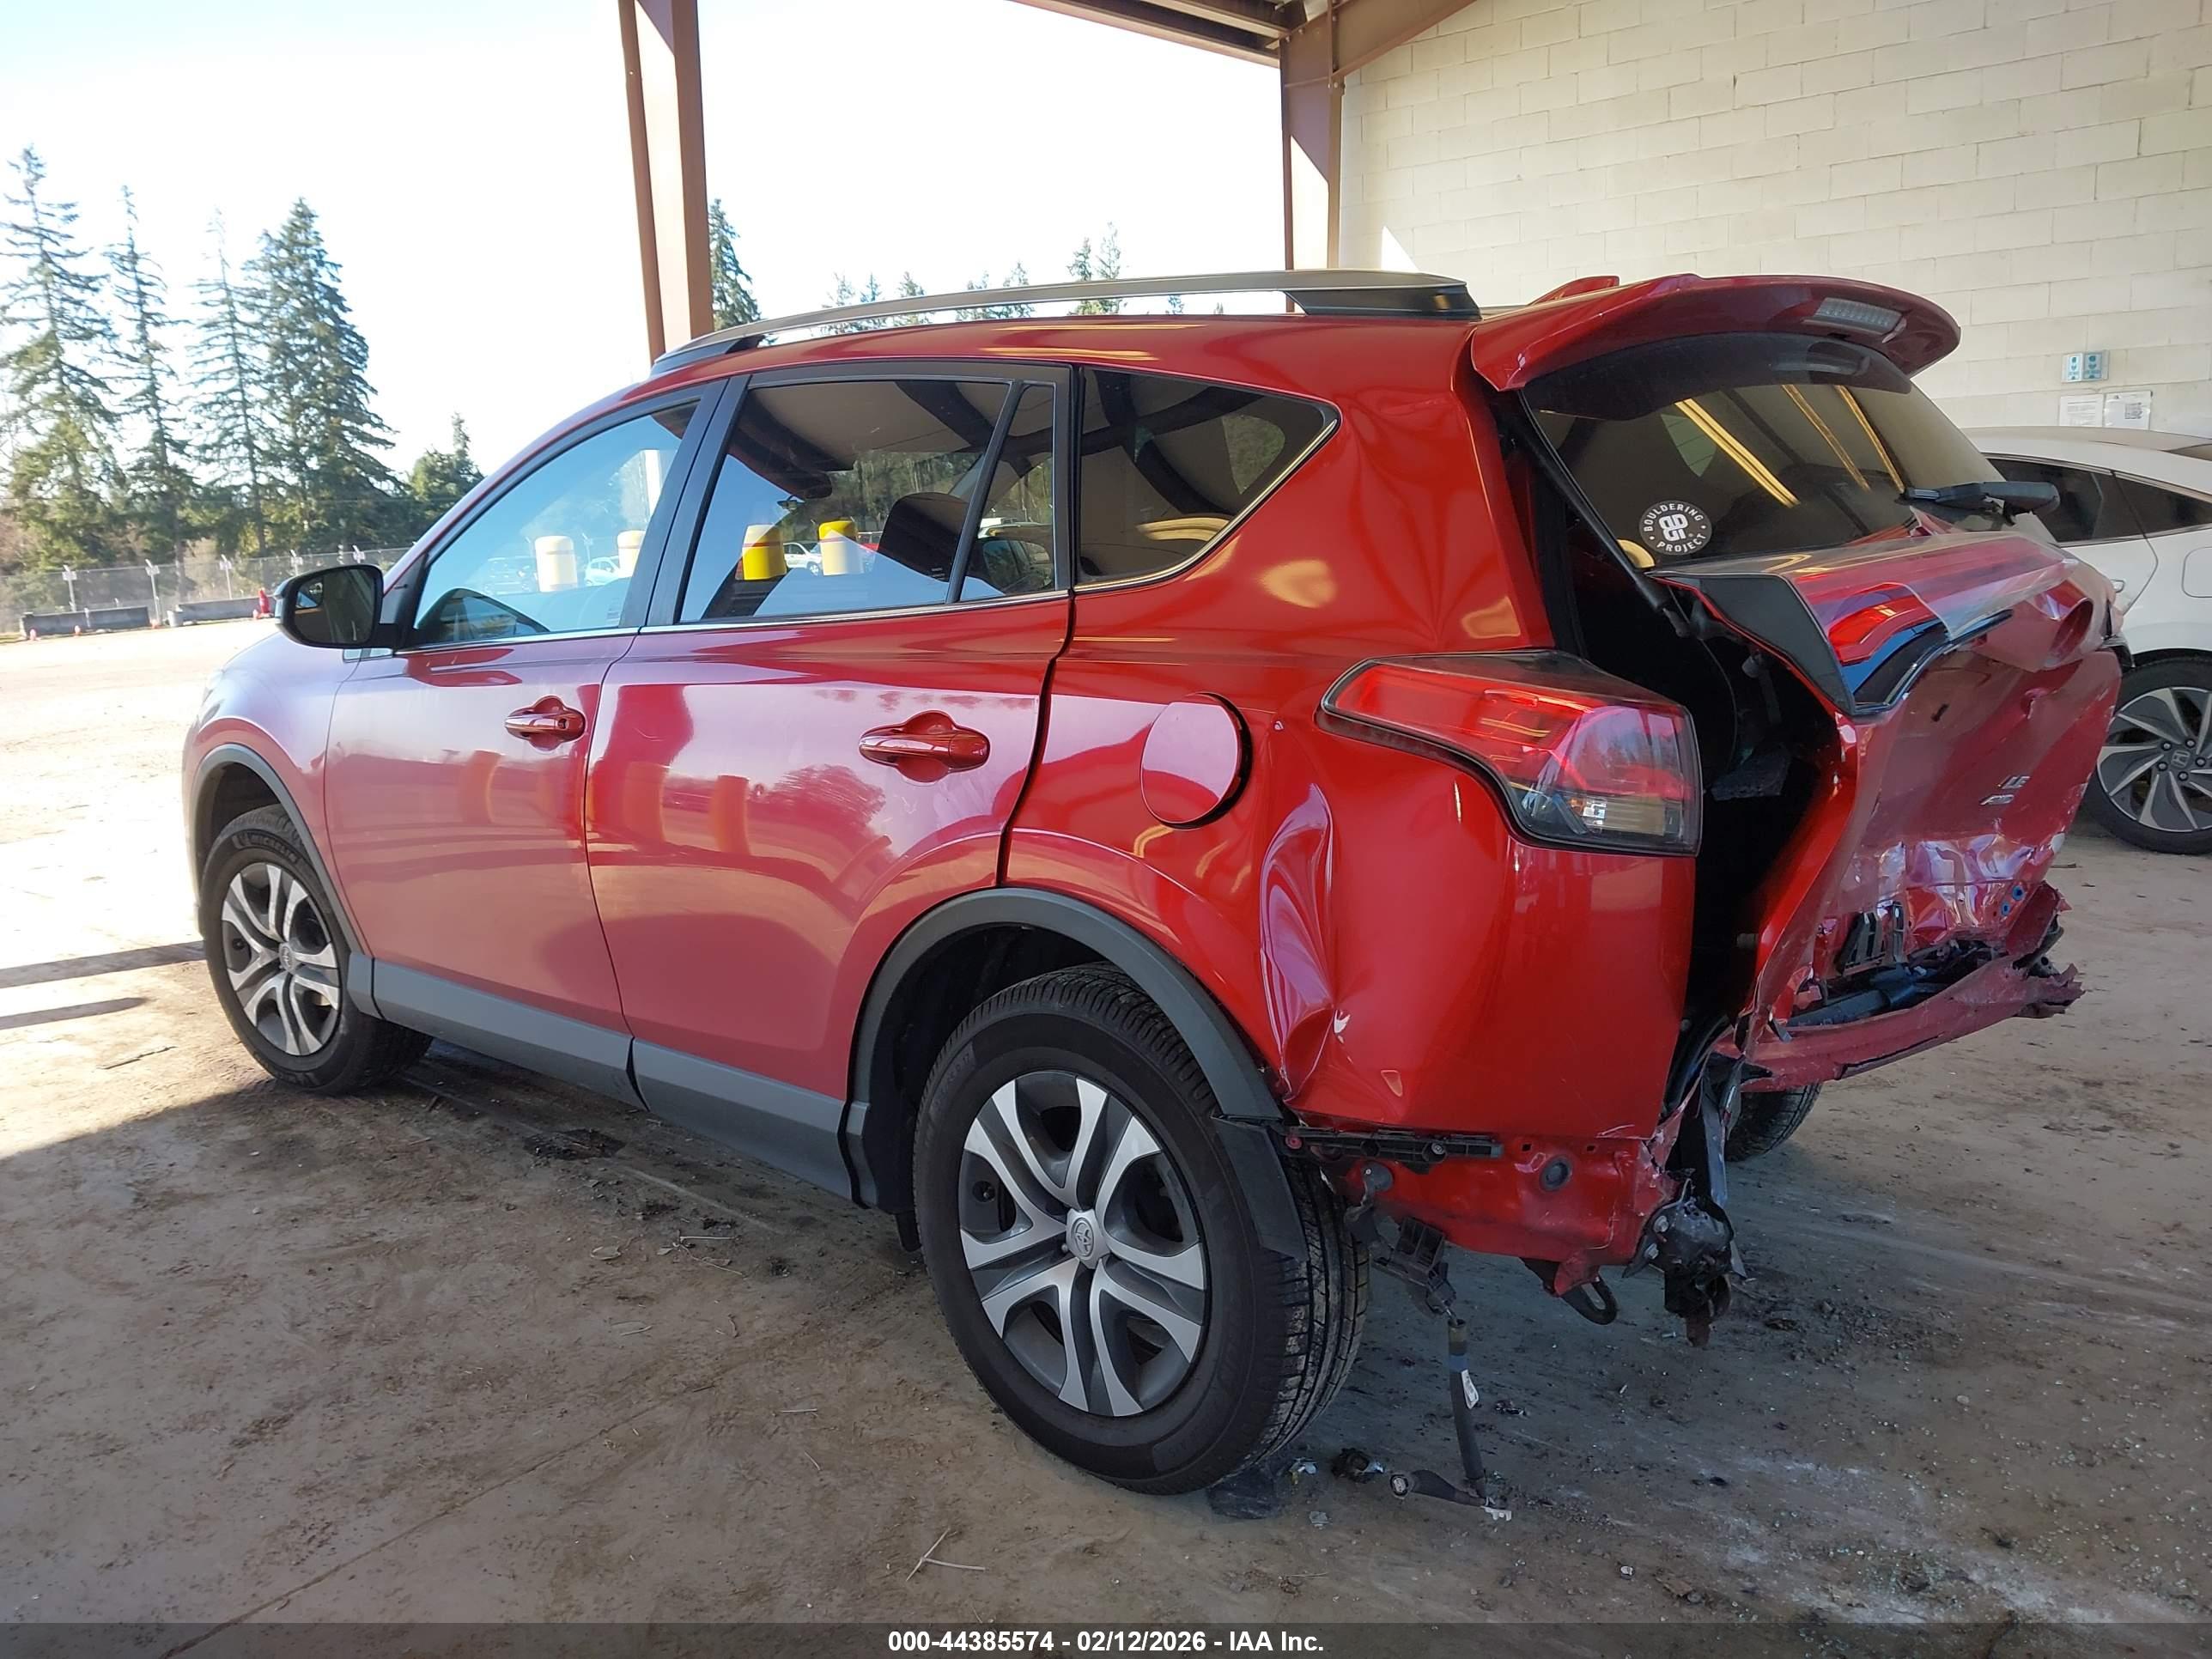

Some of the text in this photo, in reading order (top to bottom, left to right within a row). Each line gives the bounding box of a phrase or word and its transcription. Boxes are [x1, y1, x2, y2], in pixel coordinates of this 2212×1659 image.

[1643, 503, 1705, 532] BOULDERING
[1656, 532, 1707, 553] PROJECT
[2000, 775, 2031, 789] LE
